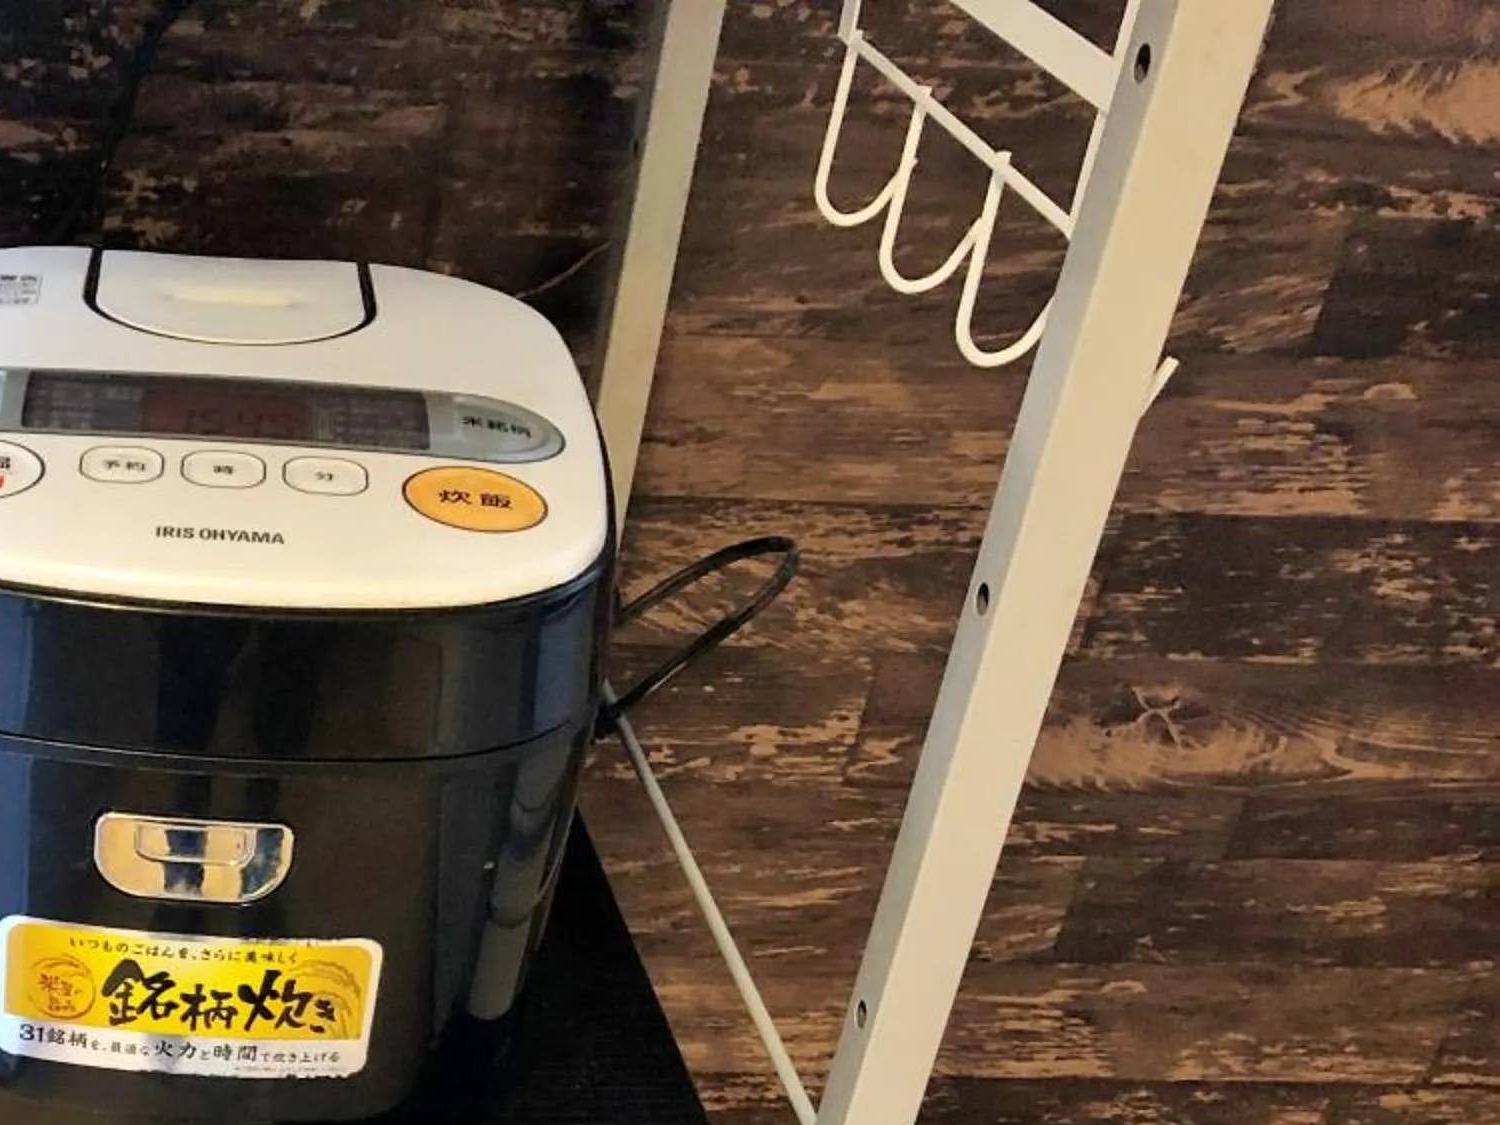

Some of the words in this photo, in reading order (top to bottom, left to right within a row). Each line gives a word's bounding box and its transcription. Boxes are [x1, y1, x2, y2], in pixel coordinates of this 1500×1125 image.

[437, 488, 513, 511] 炊飯
[155, 526, 195, 540] IRIS
[198, 528, 286, 545] OHYAMA
[101, 959, 337, 1033] 銘柄炊き
